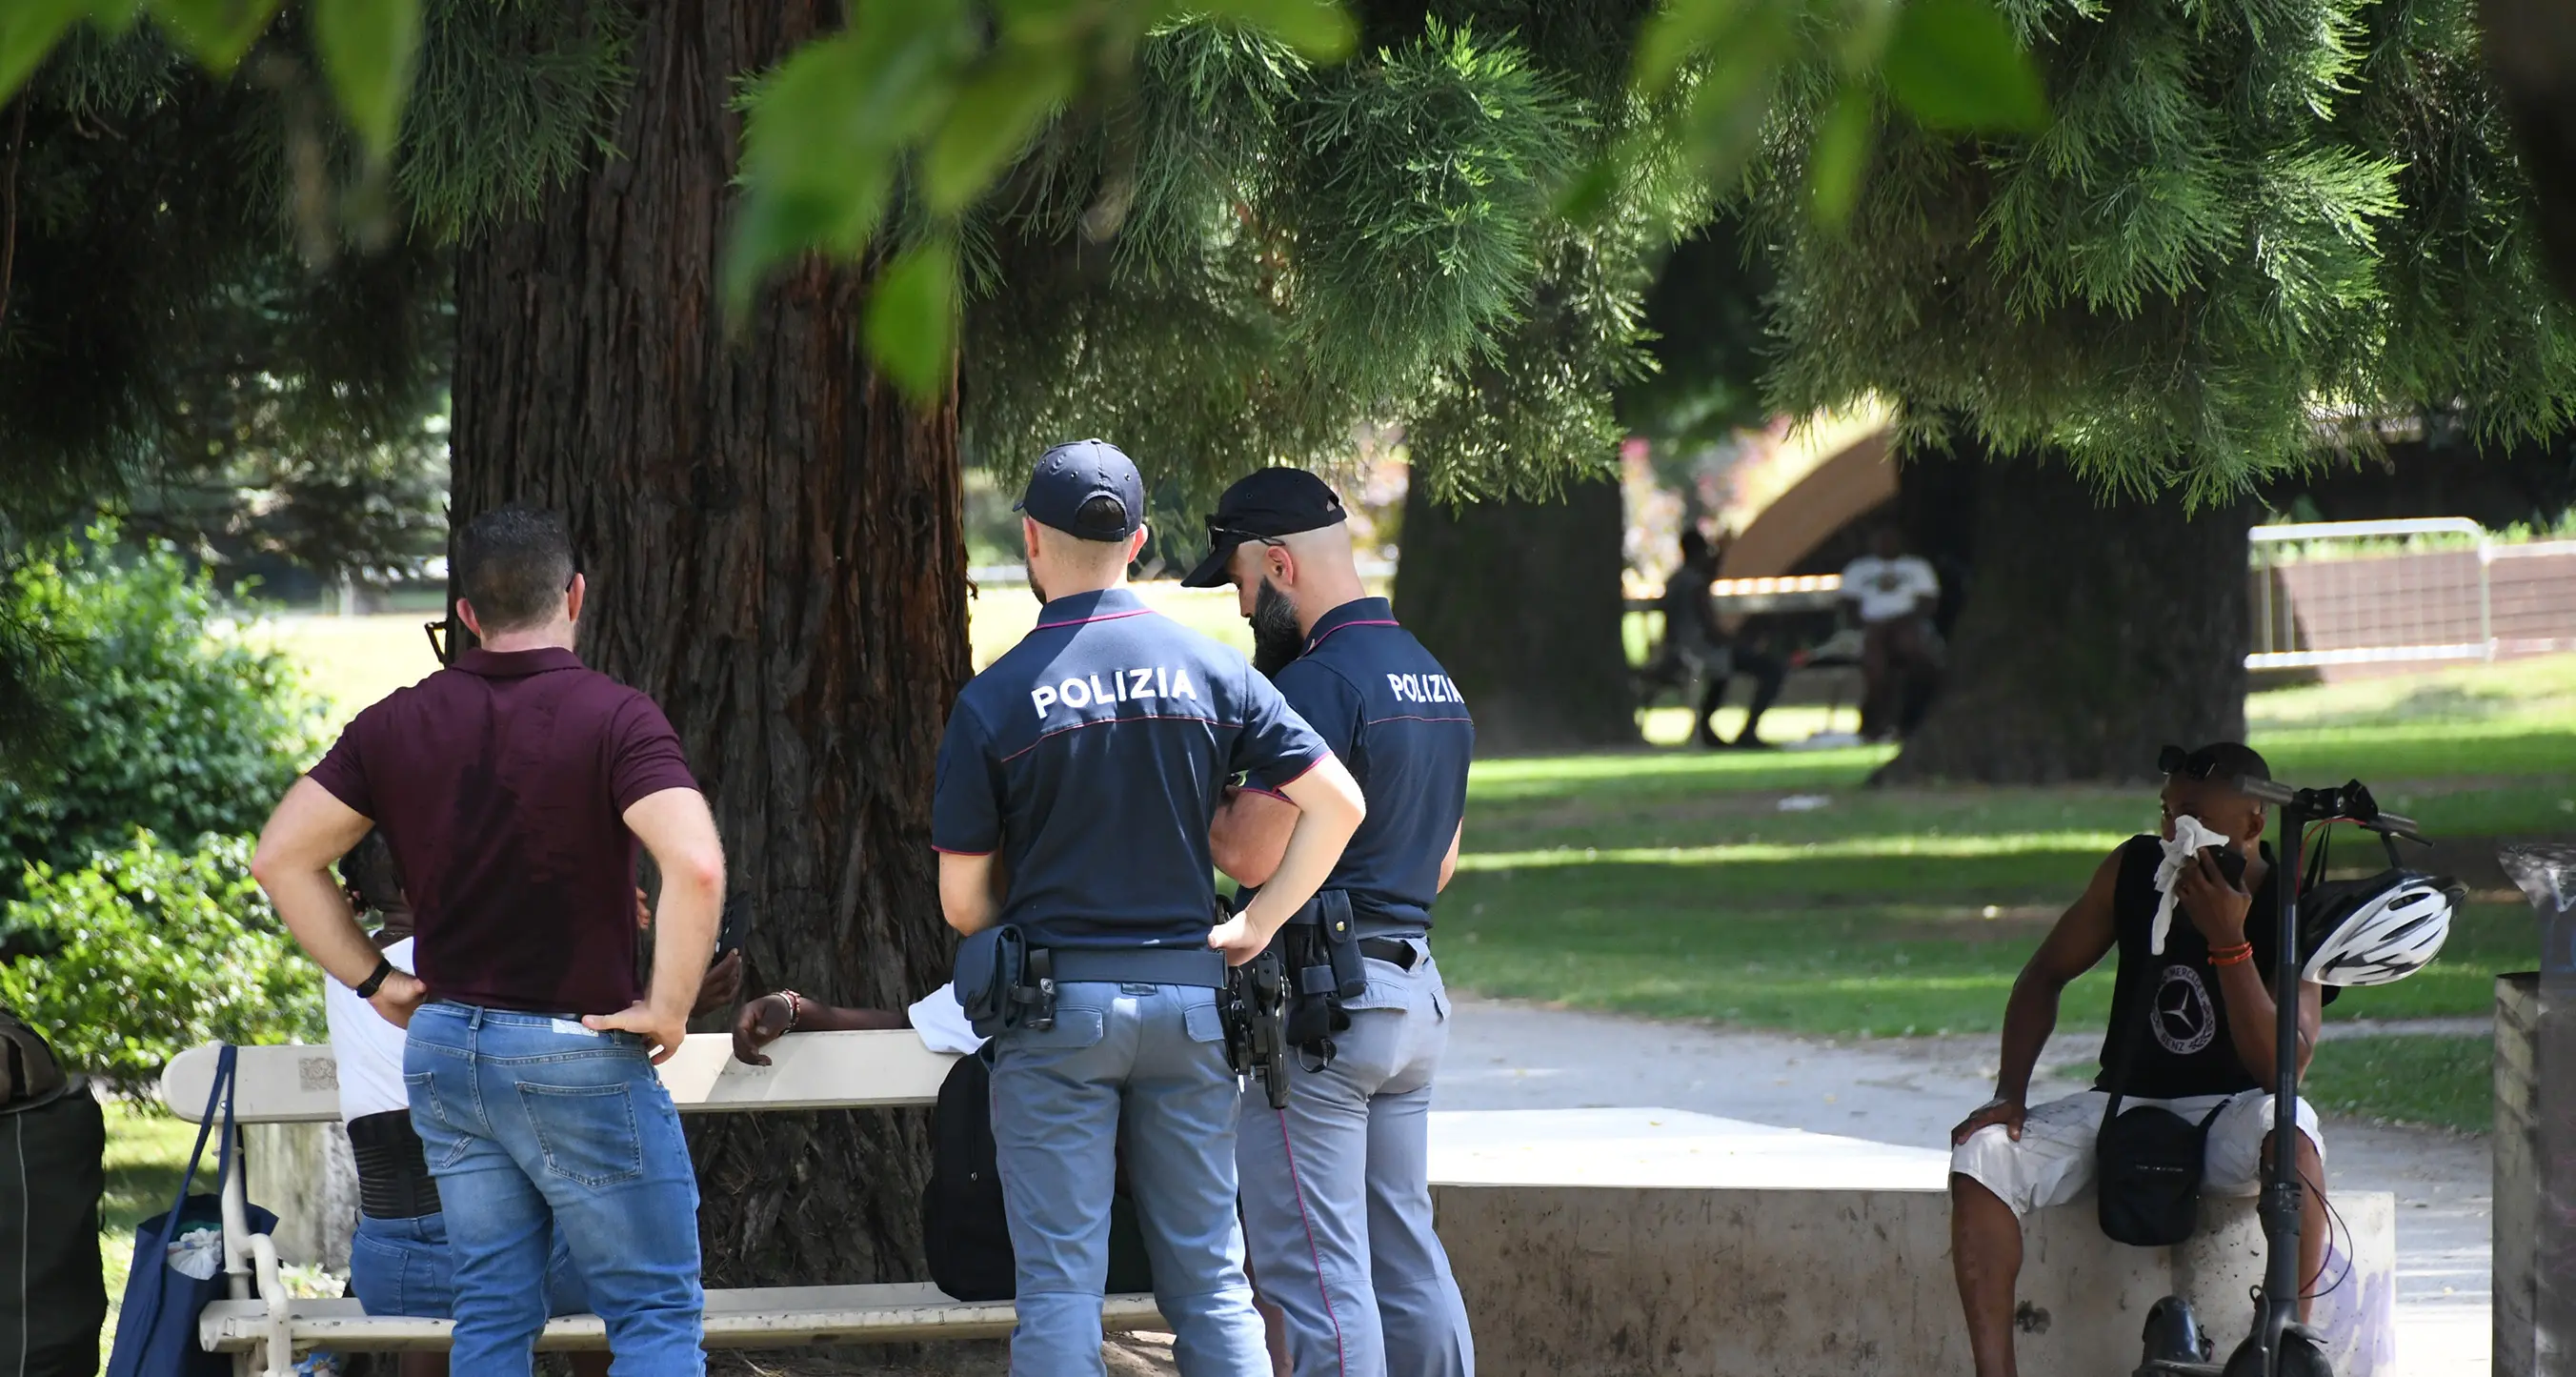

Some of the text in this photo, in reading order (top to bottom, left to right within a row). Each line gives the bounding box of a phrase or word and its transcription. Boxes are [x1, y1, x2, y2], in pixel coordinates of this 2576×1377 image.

[1030, 667, 1197, 719] POLIZIA
[1386, 673, 1465, 704] POLIZIA
[2161, 1032, 2185, 1052] BENZ
